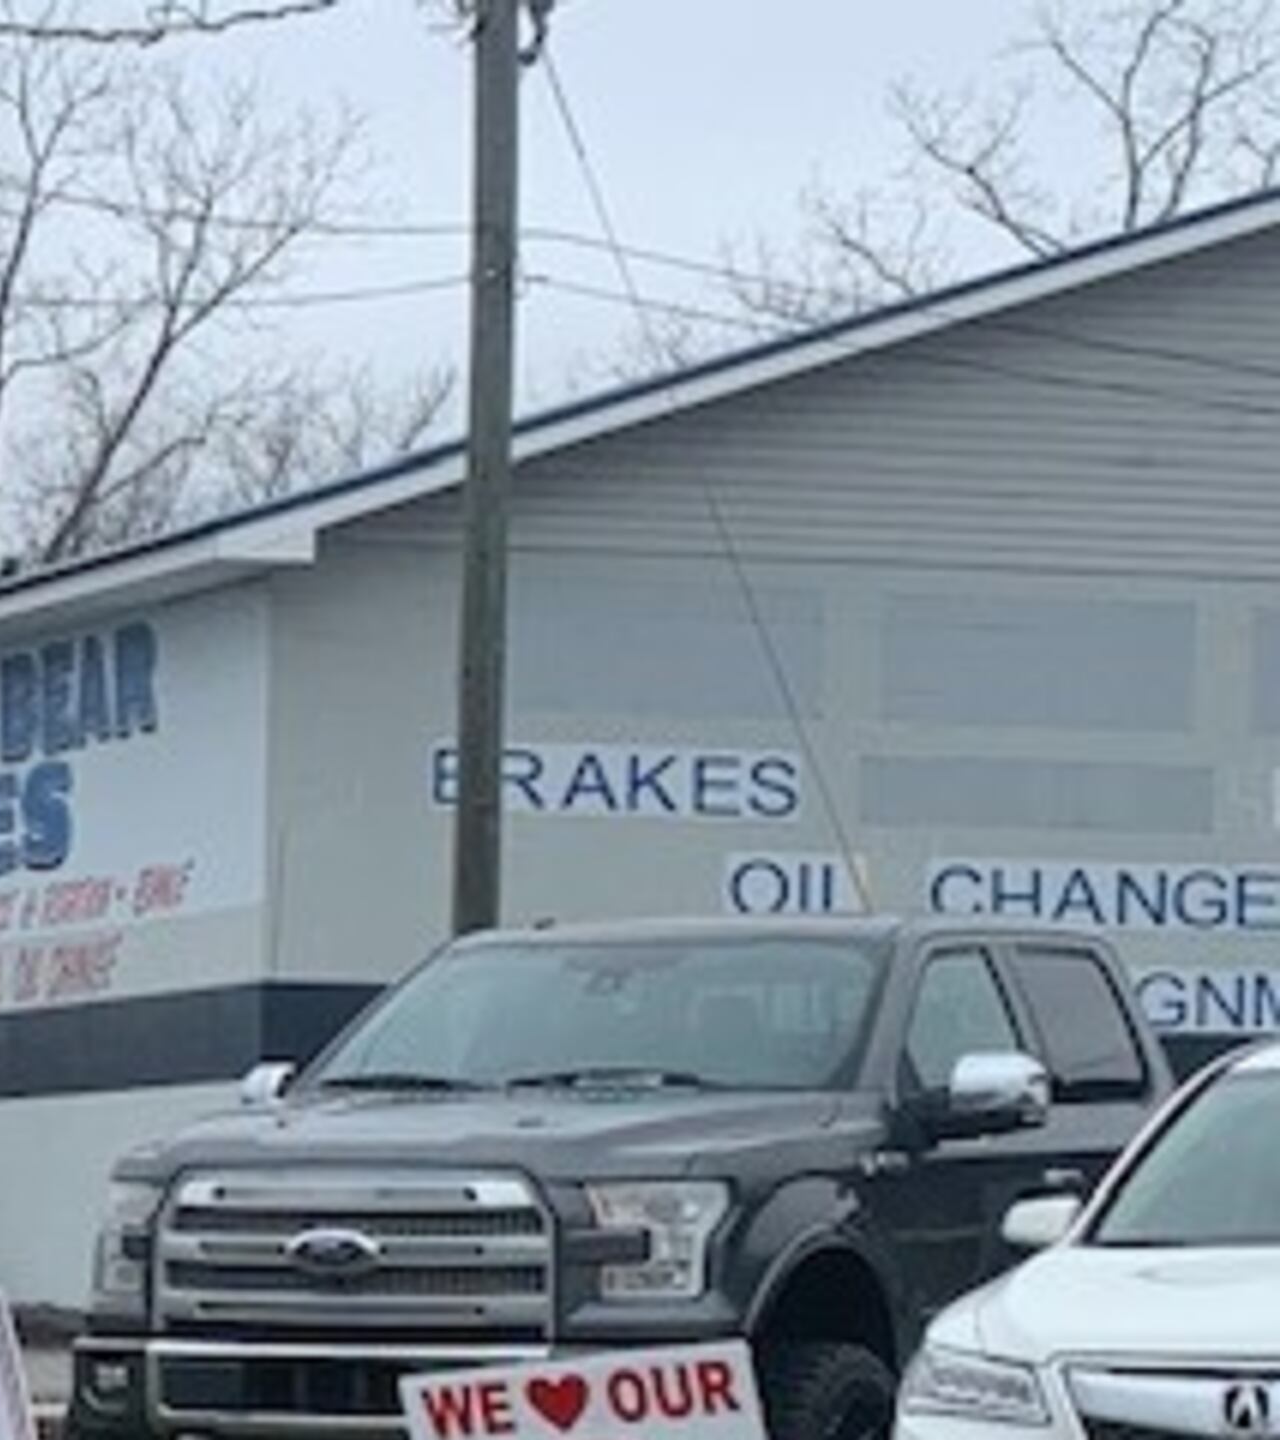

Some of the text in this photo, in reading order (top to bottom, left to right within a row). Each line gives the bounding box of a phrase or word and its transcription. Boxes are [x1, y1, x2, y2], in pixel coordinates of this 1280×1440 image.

[0, 620, 159, 764] BEAR
[930, 864, 1280, 928] CHANGE
[608, 1360, 740, 1422] OUR
